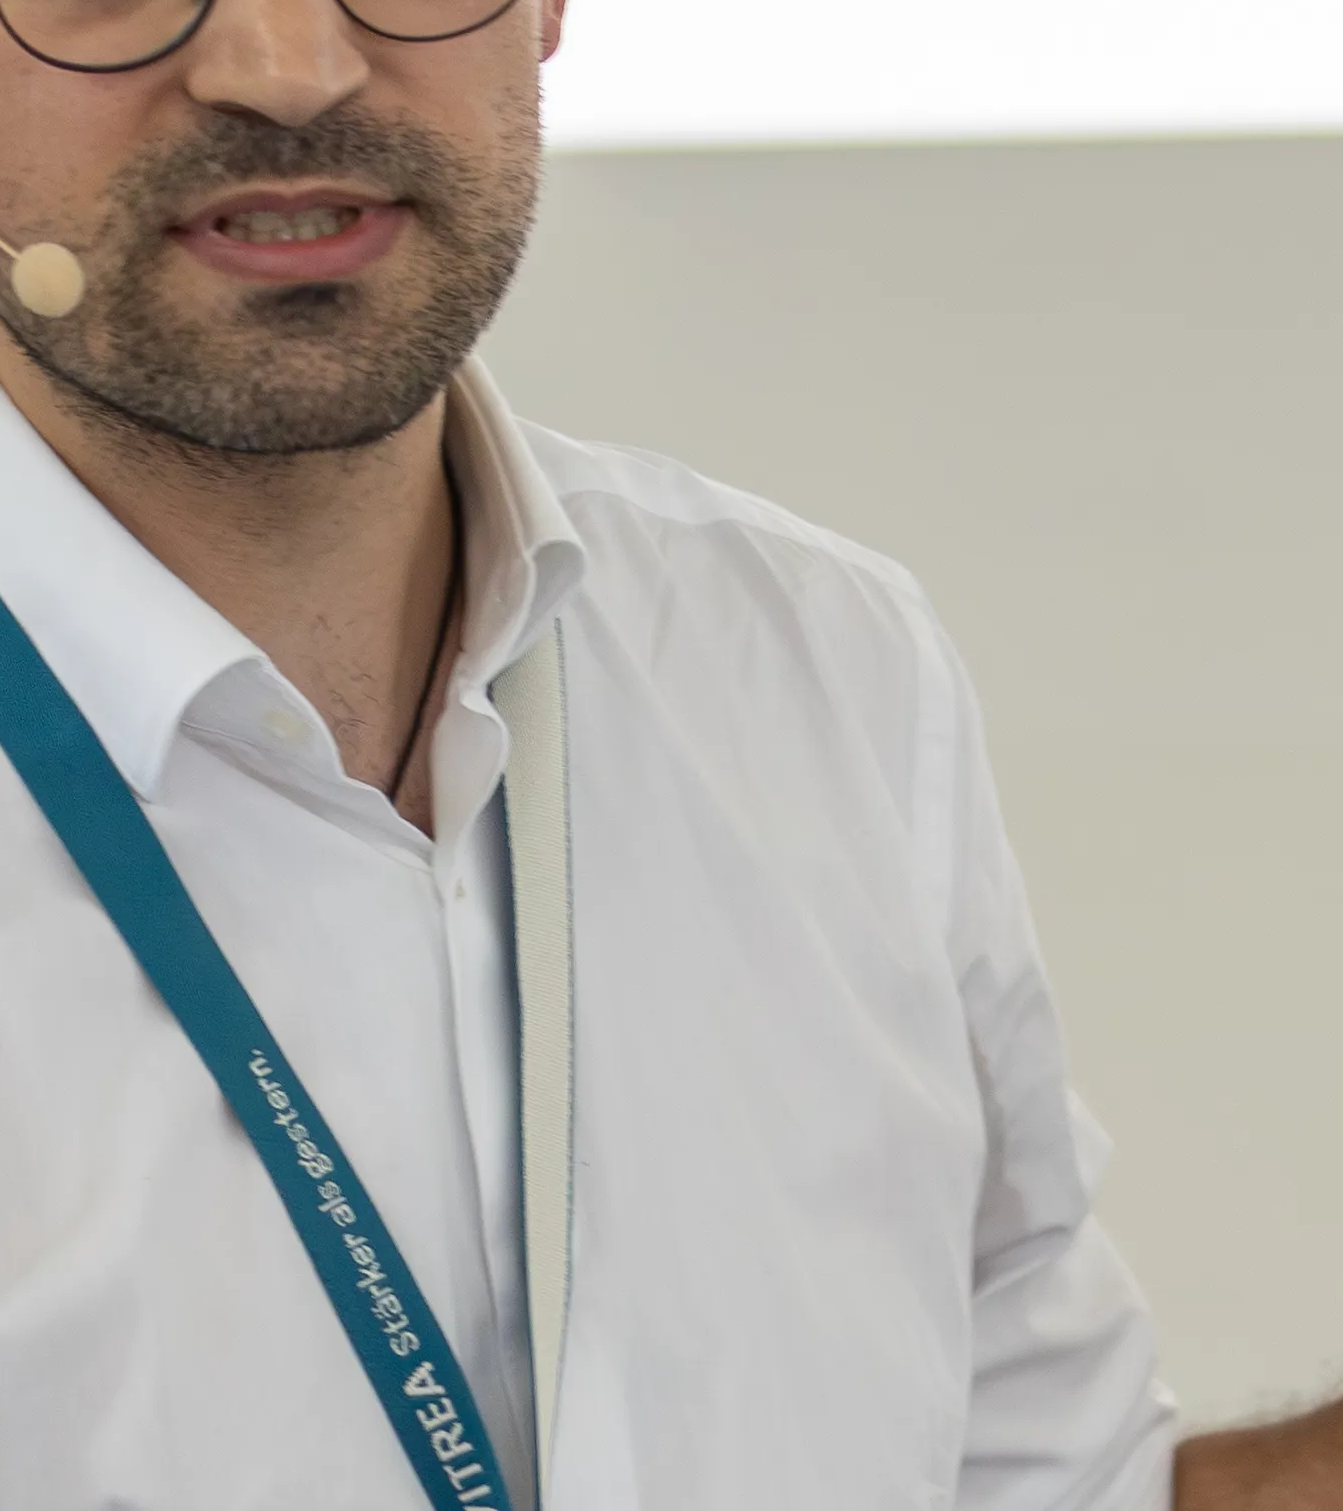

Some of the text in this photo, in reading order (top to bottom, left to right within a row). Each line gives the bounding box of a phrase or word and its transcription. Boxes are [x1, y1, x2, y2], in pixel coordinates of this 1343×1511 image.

[248, 1050, 334, 1180] gestern.
[317, 1180, 357, 1227] als
[342, 1232, 421, 1357] Stärker
